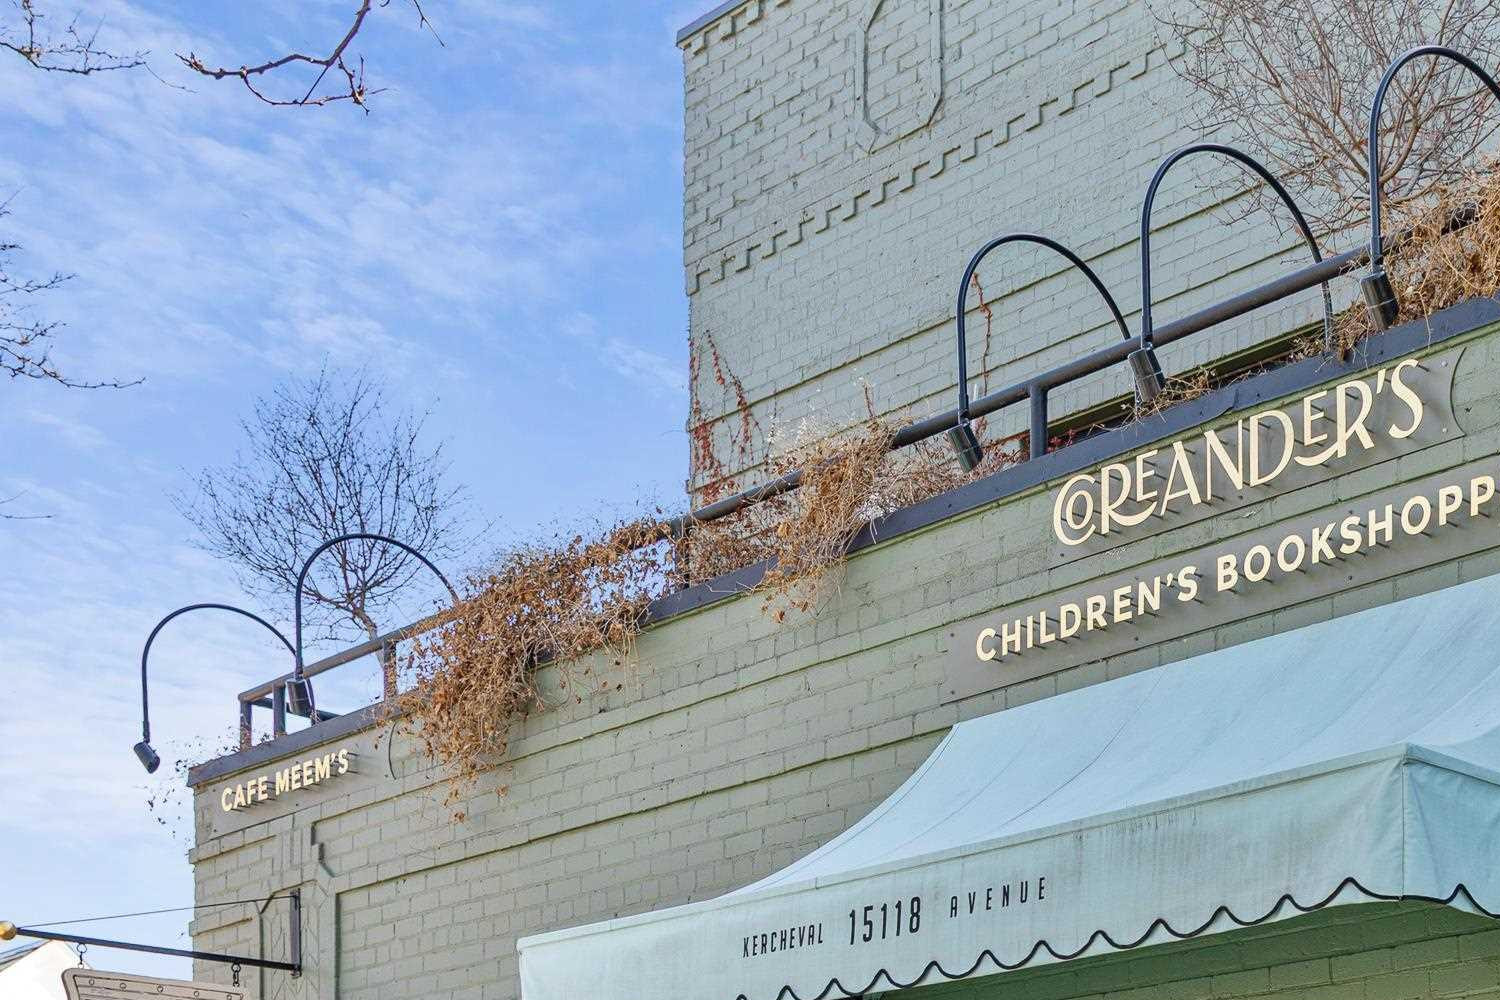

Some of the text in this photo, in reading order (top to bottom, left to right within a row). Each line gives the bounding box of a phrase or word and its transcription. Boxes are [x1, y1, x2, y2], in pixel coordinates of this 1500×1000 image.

[975, 565, 1199, 662] CHILDREN'S
[221, 748, 349, 812] CAFE MEEM'S
[743, 877, 1046, 958] KERCHEVAL 15118 AVENUE
